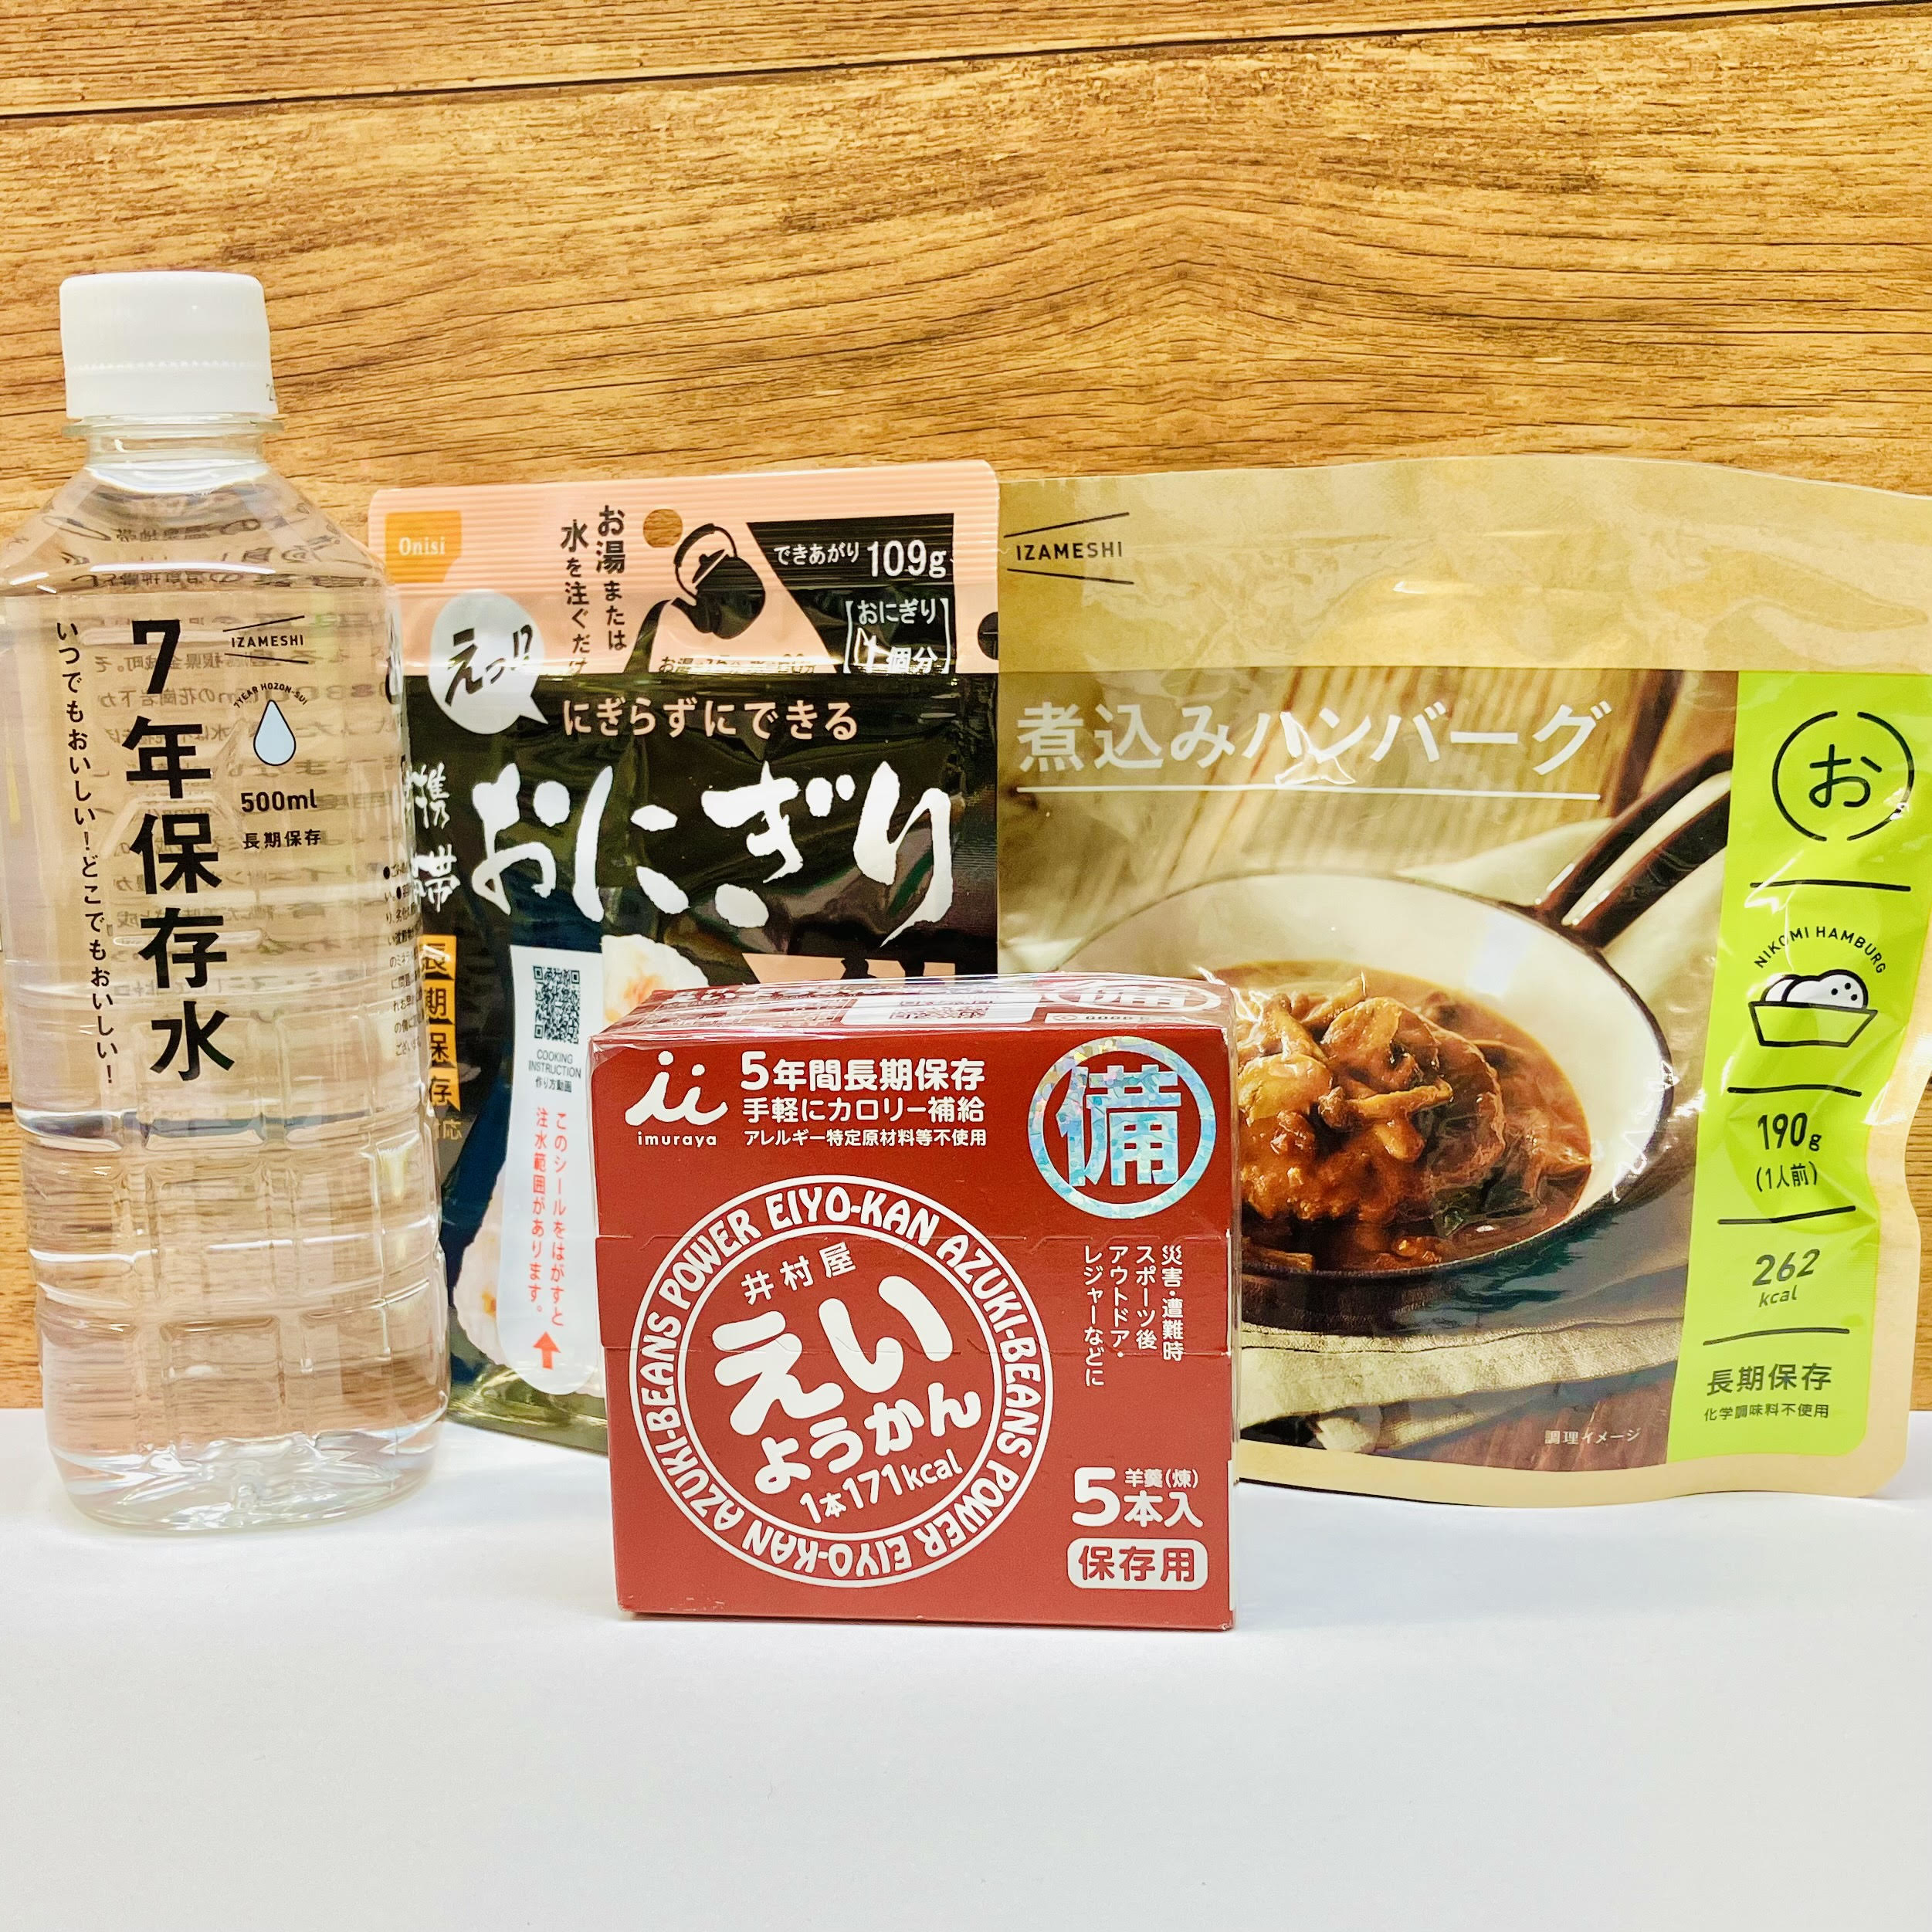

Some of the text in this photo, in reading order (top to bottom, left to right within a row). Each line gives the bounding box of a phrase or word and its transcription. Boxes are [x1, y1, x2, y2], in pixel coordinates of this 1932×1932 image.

[398, 537, 446, 556] Onisi
[773, 540, 947, 579] できあがり 109g
[1016, 541, 1124, 561] IZAMESHI
[561, 518, 591, 674] 水を注ぐだけ
[595, 504, 628, 651] お湯または
[858, 598, 937, 625] おにぎり
[231, 634, 303, 648] IZAMESHI
[562, 696, 858, 741] にぎらずにできる
[1016, 700, 1612, 776] 煮込みハンバーグ
[1808, 743, 1883, 808] お
[240, 788, 317, 812] 500ml
[122, 619, 235, 1082] 7年保存水
[242, 829, 321, 849] 長期保存
[471, 760, 952, 947] おにぎり
[1754, 926, 1887, 974] NIKOMI HAMBURG
[528, 1060, 581, 1080] INSTRUCTION
[537, 1049, 573, 1065] COOKING
[740, 1050, 985, 1092] 5年間長期保存
[535, 1078, 572, 1093] 作り方動画
[742, 1096, 985, 1124] 手軽にカロリー補給
[1057, 1066, 1181, 1187] 備
[637, 1130, 717, 1148] imuraya
[744, 1127, 987, 1147] アレルギー特定原材料等不使用
[1757, 1111, 1822, 1152] 190g
[1755, 1161, 1818, 1192] (1人前)
[528, 1107, 549, 1313] 注水範囲があります。
[550, 1111, 568, 1328] このシールをはがすと
[741, 1242, 856, 1304] 井村屋
[1752, 1249, 1820, 1287] 262
[1135, 1246, 1158, 1350] スポーツ後
[1161, 1245, 1185, 1362] 災害・遭難時
[1758, 1285, 1798, 1307] kcal
[1083, 1245, 1105, 1387] レジャーなどに
[640, 1186, 1042, 1578] POWER EIYO-KAN AZUKI-BEANS POWER EIYO-KAN AZUKI-BEANS
[1707, 1362, 1832, 1396] 長期保存
[1703, 1403, 1829, 1422] 化学調味料不使用
[1544, 1426, 1642, 1445] 調理イメージ
[1072, 1466, 1204, 1528] 5本入
[1078, 1545, 1195, 1582] 保存用
